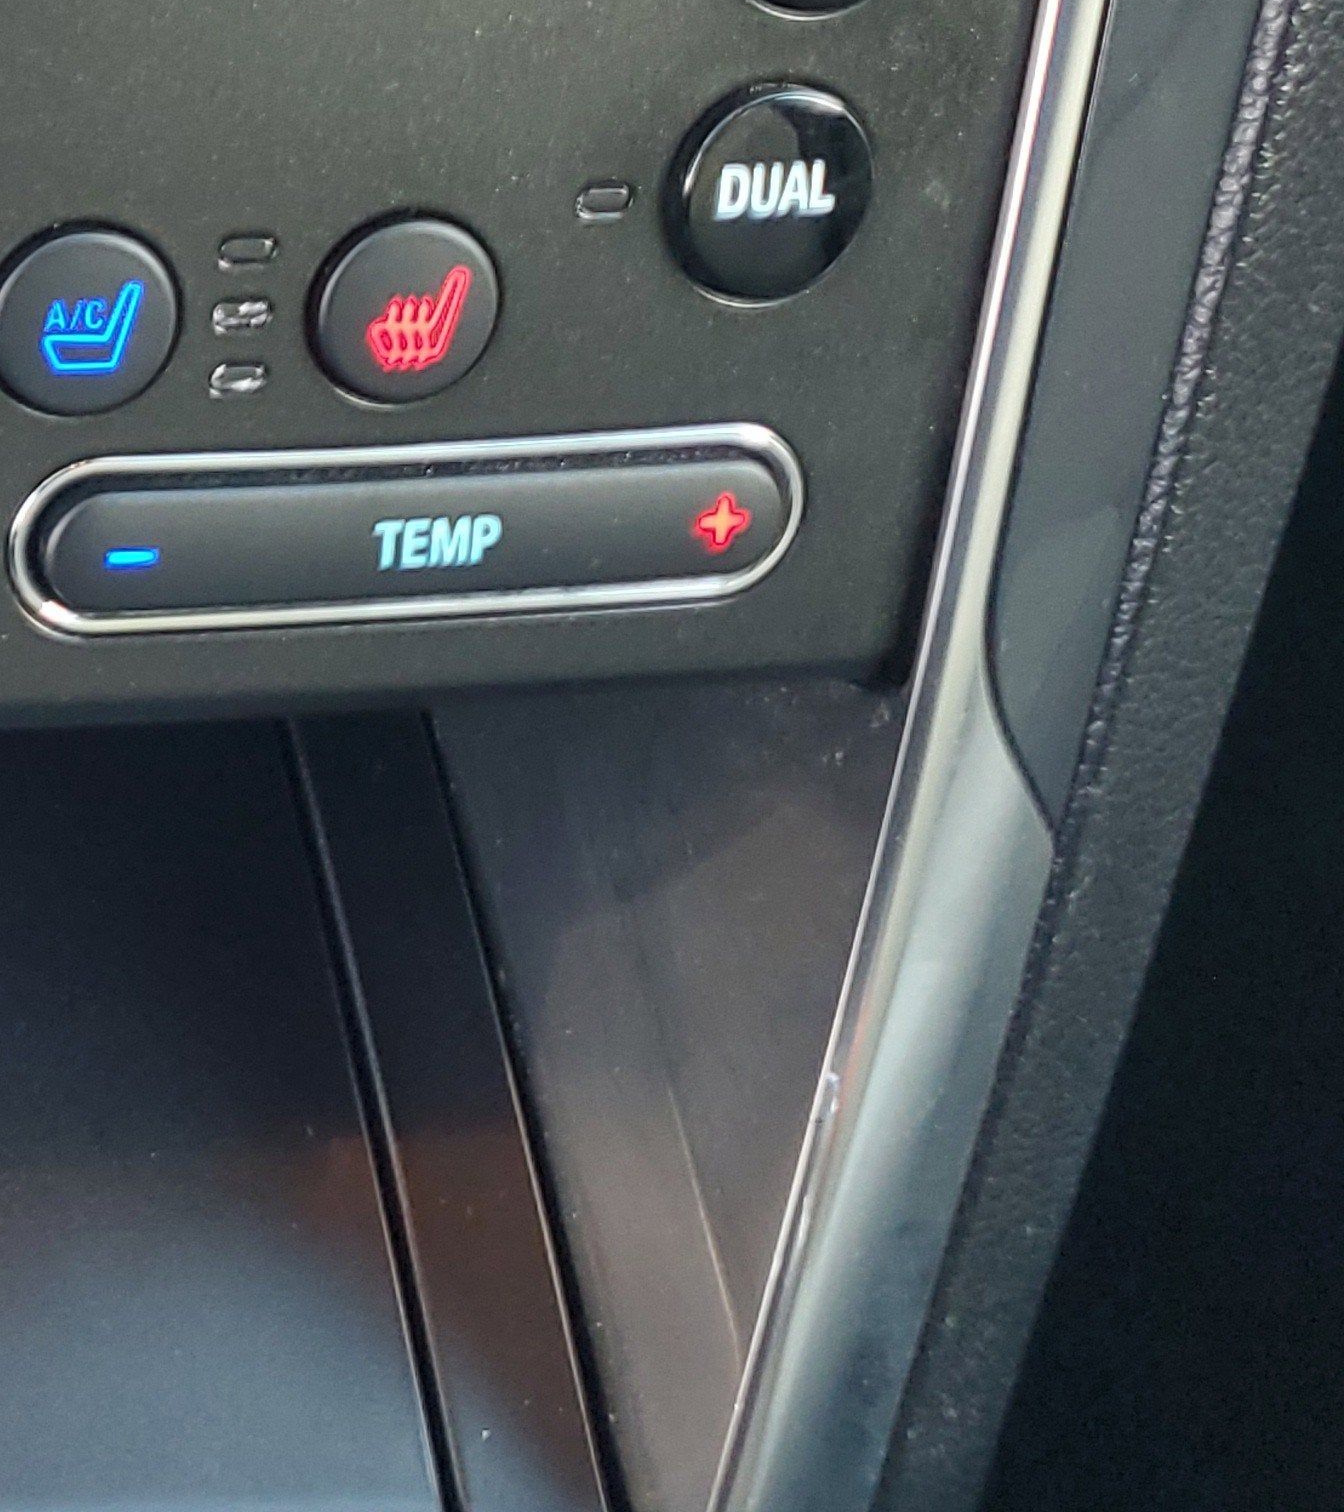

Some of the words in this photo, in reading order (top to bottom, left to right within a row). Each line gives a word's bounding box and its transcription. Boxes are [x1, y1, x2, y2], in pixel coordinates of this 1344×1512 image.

[714, 159, 835, 221] DUAL
[44, 298, 107, 333] A/C
[373, 514, 503, 570] TEMP
